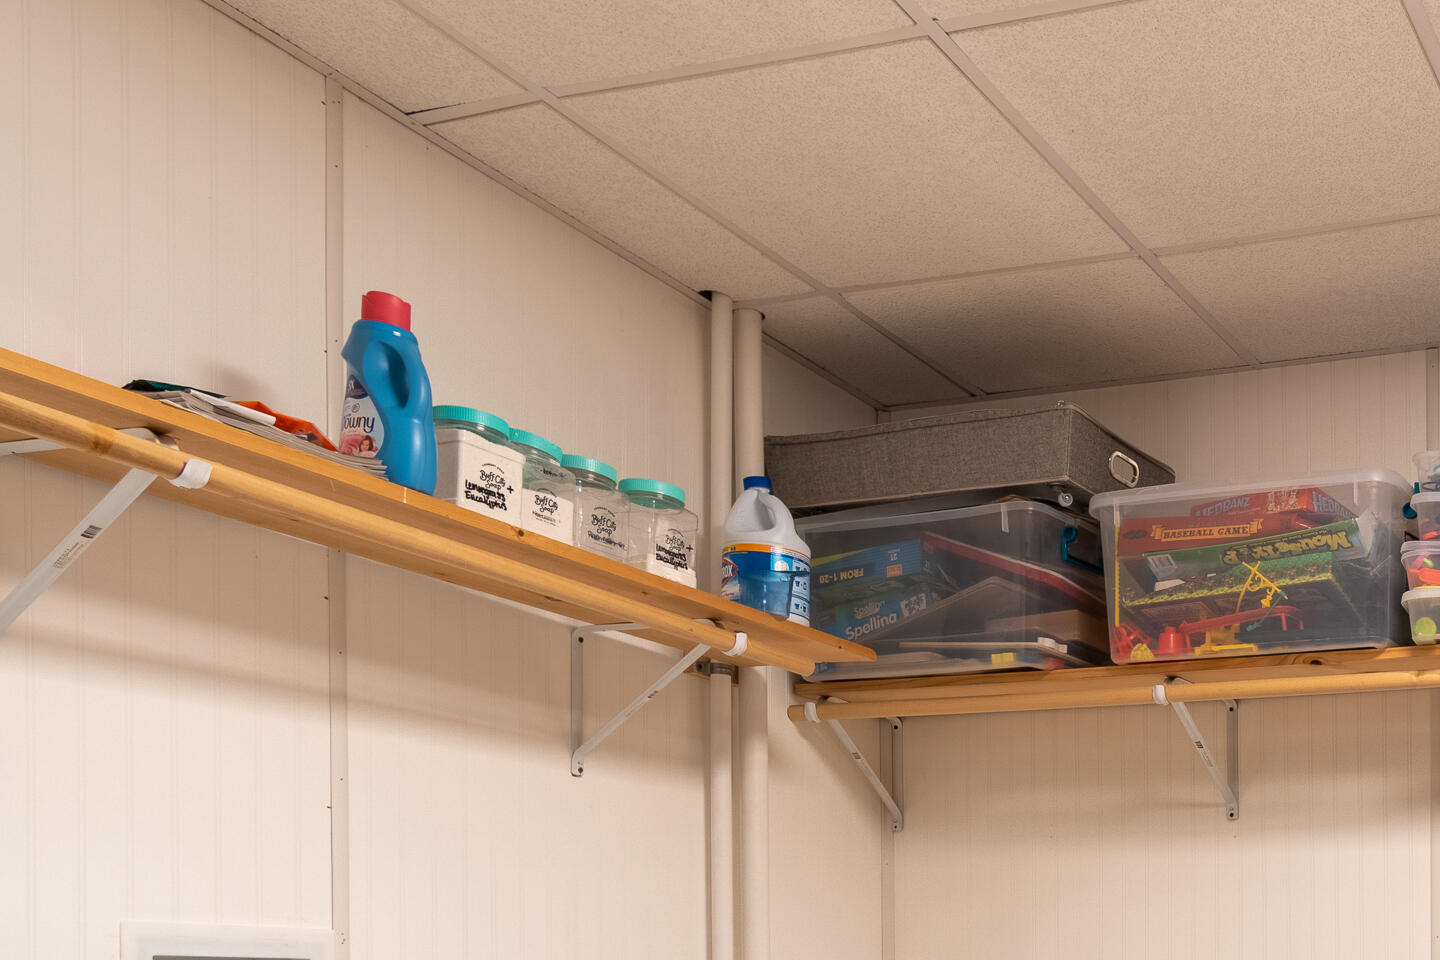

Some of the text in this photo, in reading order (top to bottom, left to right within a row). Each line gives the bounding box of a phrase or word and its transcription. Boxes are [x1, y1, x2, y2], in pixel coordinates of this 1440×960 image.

[344, 415, 375, 433] owny
[1163, 526, 1249, 539] BASEBALL GAME
[840, 568, 864, 580] FROM
